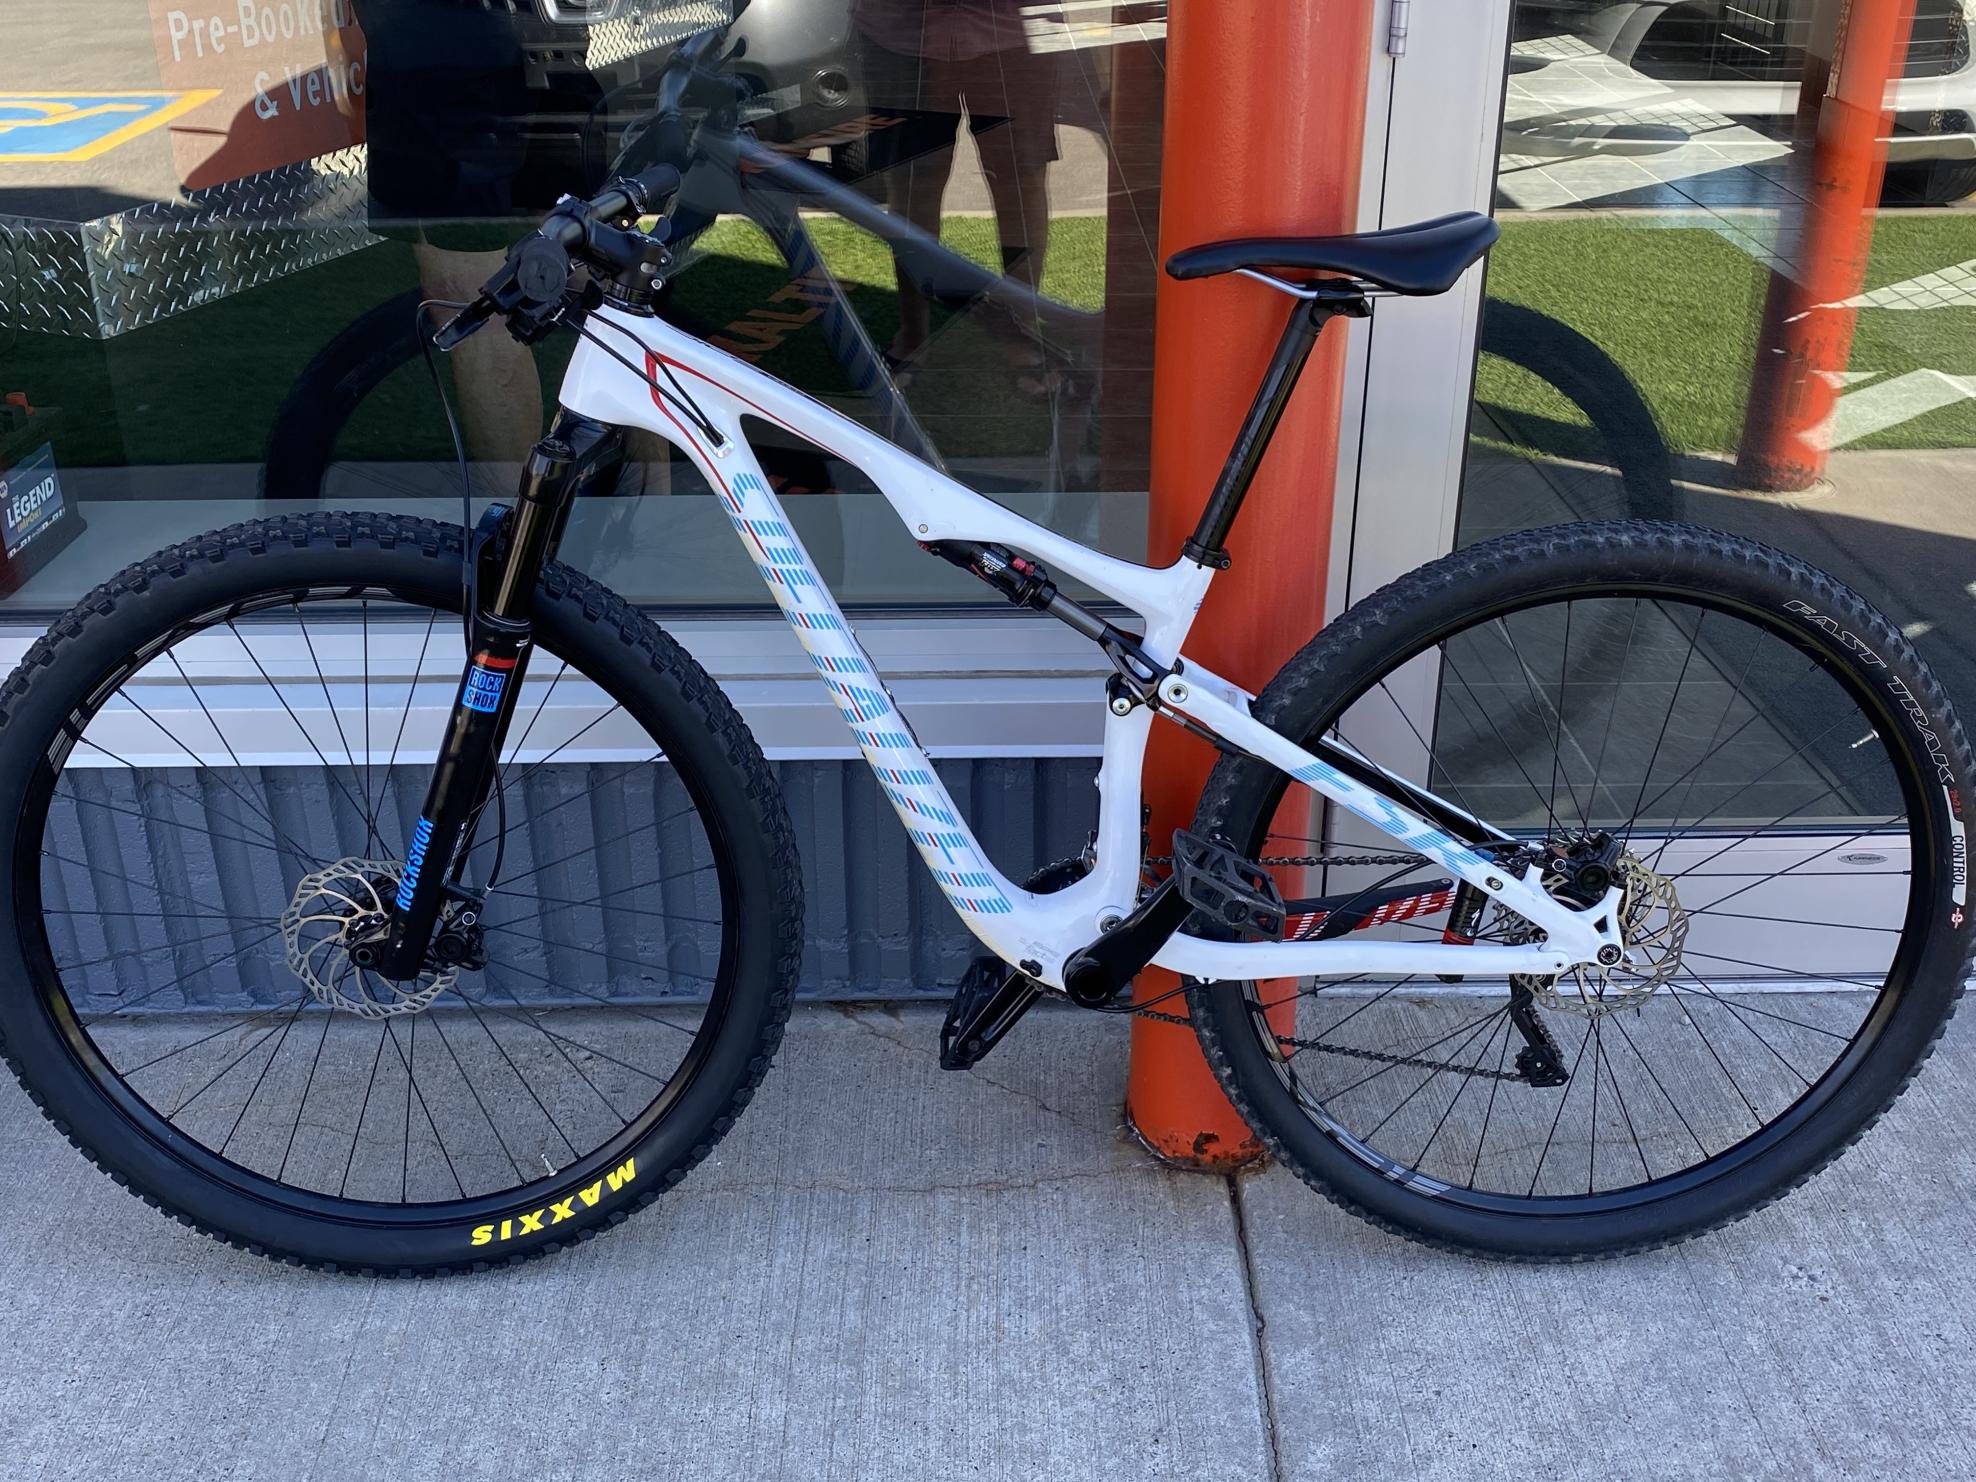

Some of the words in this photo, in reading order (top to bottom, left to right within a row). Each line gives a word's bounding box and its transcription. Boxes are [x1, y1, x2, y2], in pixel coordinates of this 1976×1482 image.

[254, 71, 280, 120] &
[6, 477, 55, 529] LEGEND
[17, 508, 43, 533] IMPORT
[466, 690, 497, 709] SHOX
[470, 673, 502, 692] ROCK
[1783, 600, 1887, 669] FAST
[1887, 675, 1955, 784] TRAK
[1289, 762, 1484, 876] FSR
[395, 815, 434, 912] ROCKSHOX
[1952, 835, 1966, 888] CONTROL
[470, 1157, 637, 1246] MAXXIS
